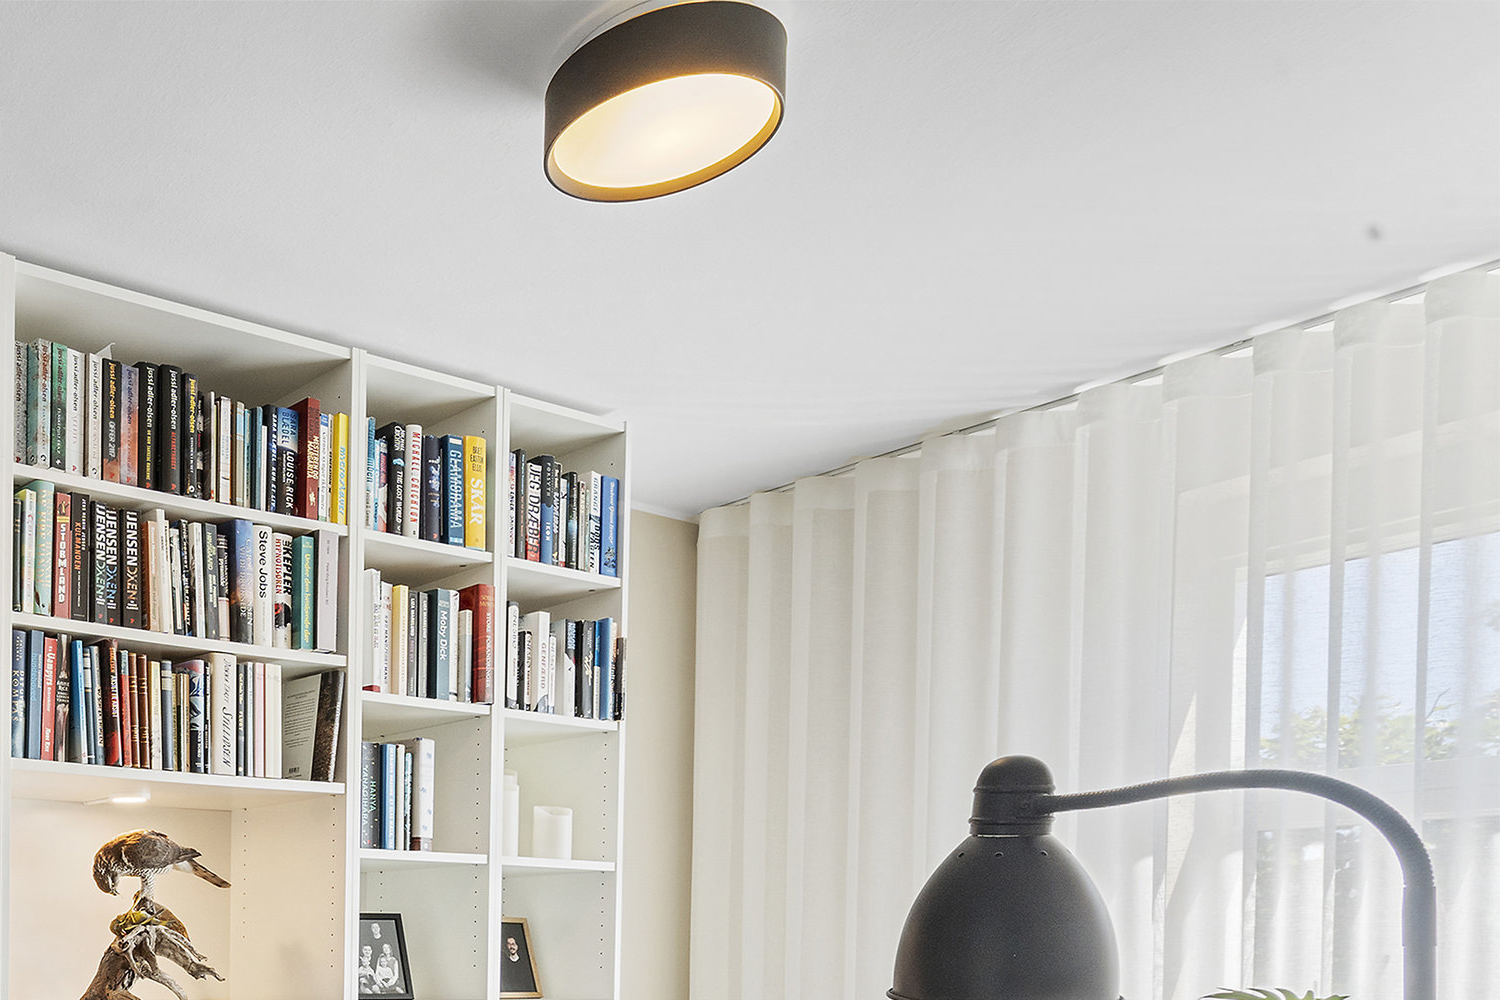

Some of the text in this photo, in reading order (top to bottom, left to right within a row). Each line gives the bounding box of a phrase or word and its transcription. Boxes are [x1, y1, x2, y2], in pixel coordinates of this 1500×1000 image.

[146, 367, 154, 385] jussi
[281, 412, 290, 444] BLÆDEL
[286, 451, 294, 509] LOUISE RICK
[450, 450, 462, 529] GLAMORAMA
[96, 508, 105, 560] JENSEN
[528, 465, 540, 553] JEG DRÆBER
[106, 514, 117, 565] JENSEN
[127, 515, 137, 566] JENSEN
[259, 530, 268, 598] Steve Jobs
[283, 547, 292, 595] KEPLER
